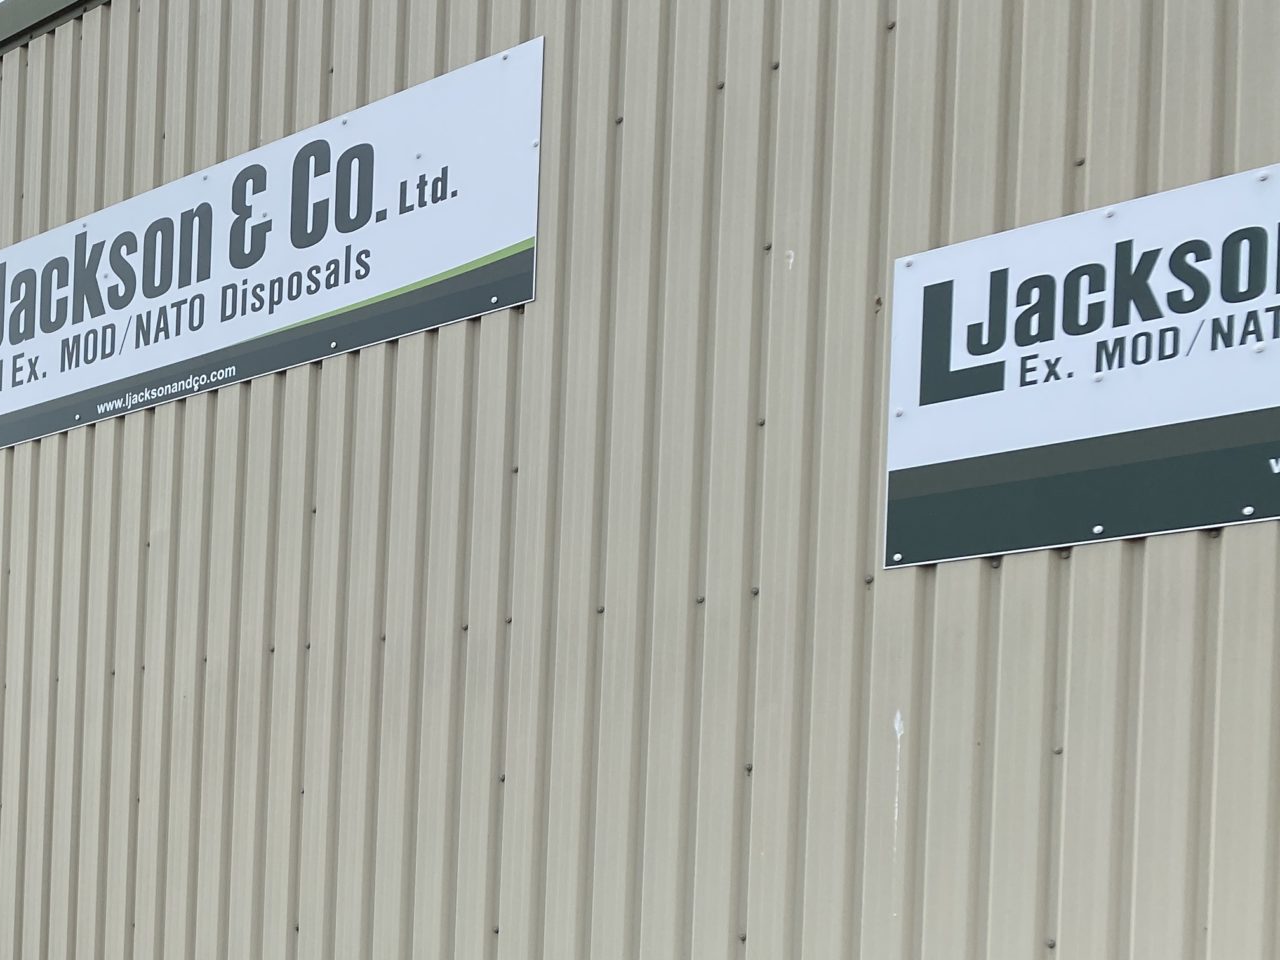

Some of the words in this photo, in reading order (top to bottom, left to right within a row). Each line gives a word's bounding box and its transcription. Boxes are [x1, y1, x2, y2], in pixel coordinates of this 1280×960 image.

[228, 163, 273, 270] &
[289, 138, 388, 250] Co.
[398, 165, 458, 216] Ltd.
[11, 352, 48, 388] Ex.
[60, 293, 206, 373] MOD/NATO
[220, 244, 372, 323] Disposals
[1019, 353, 1074, 388] Ex.
